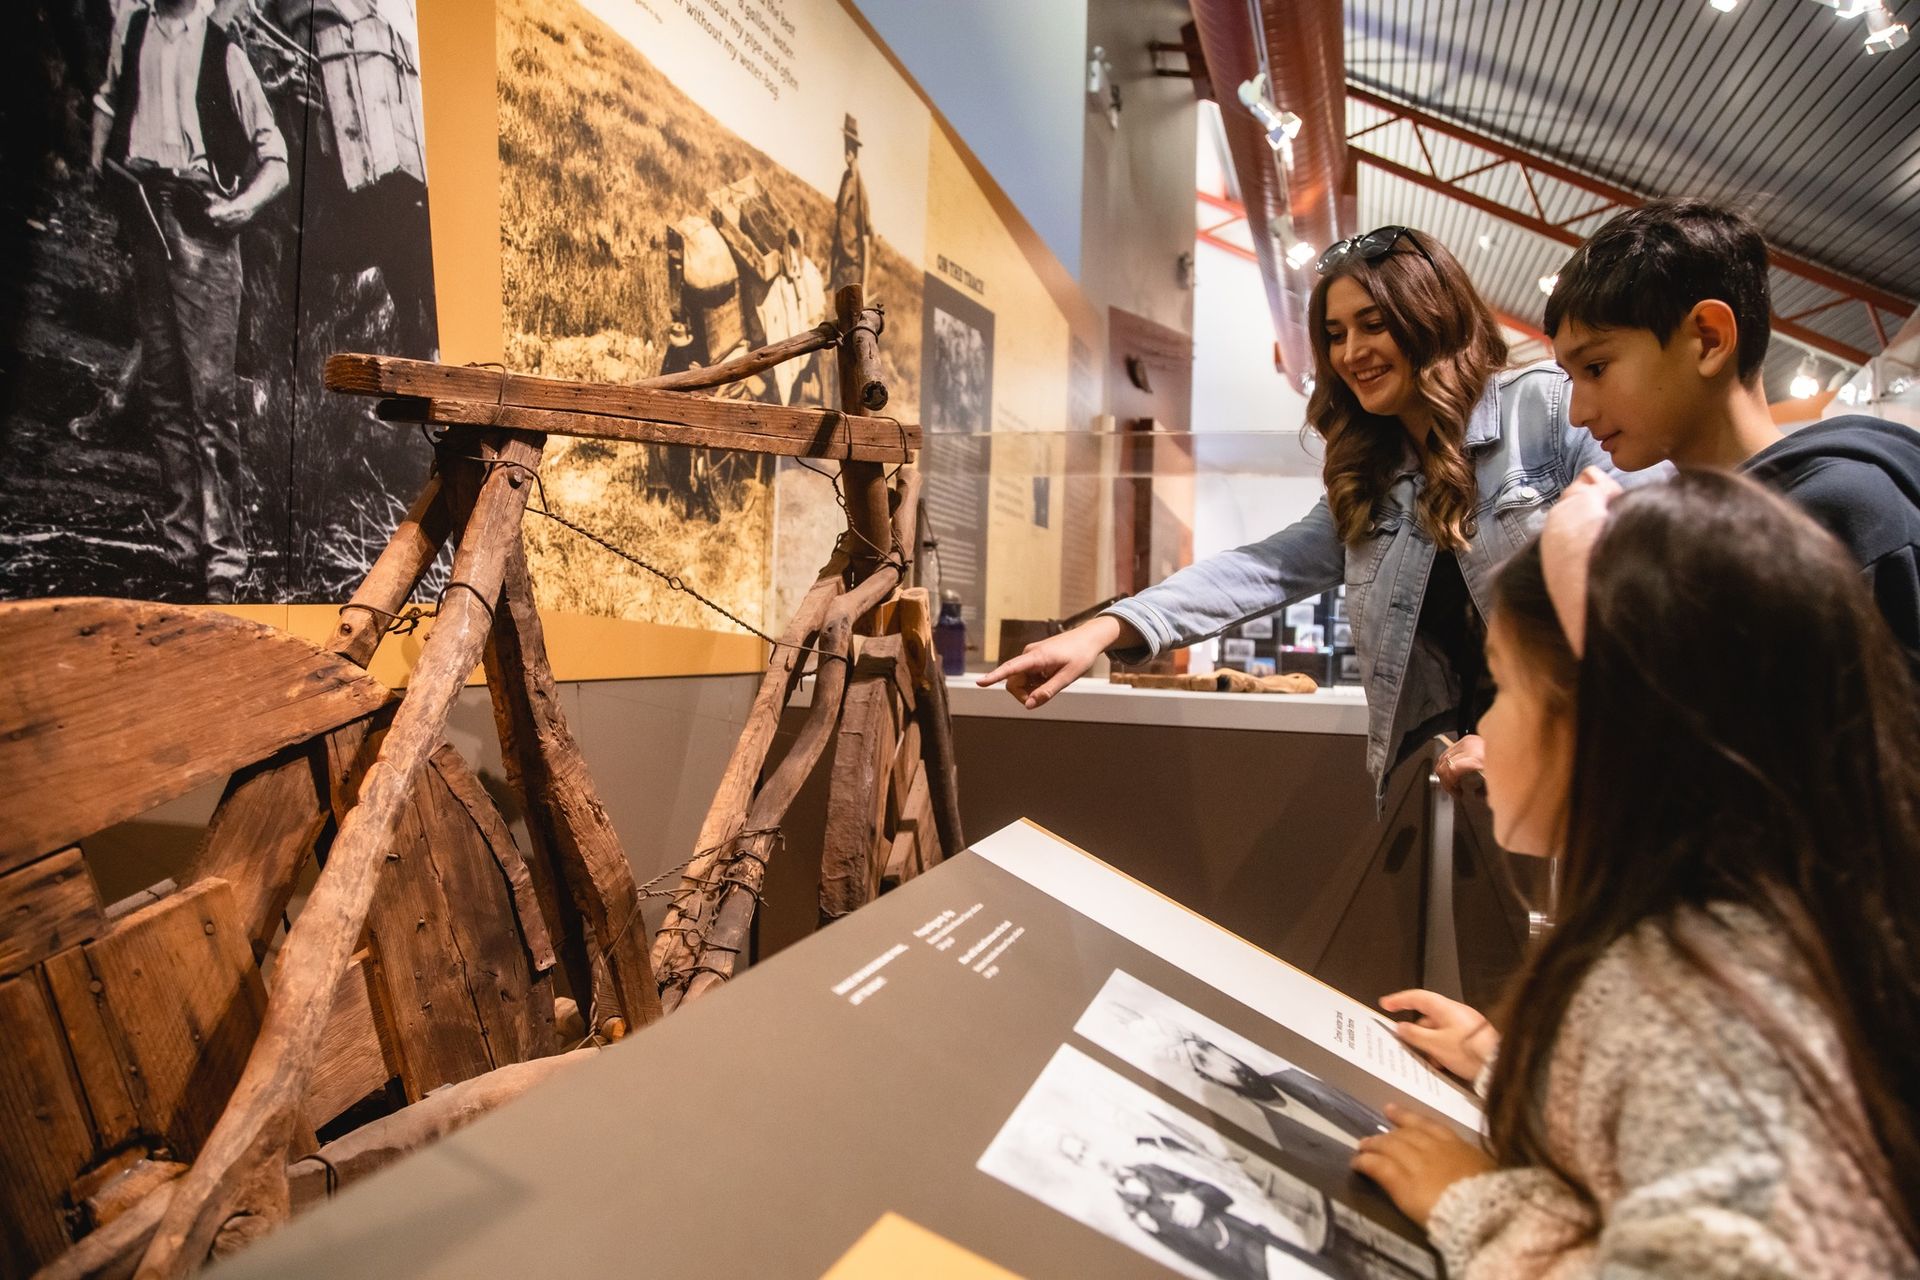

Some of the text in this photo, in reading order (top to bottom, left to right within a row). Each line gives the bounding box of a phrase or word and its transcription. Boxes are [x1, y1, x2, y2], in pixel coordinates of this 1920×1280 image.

[686, 2, 723, 45] without
[723, 38, 738, 61] my
[745, 5, 770, 37] gallon
[780, 10, 796, 38] best
[730, 16, 744, 39] my
[744, 32, 762, 55] pipe
[763, 51, 779, 71] and
